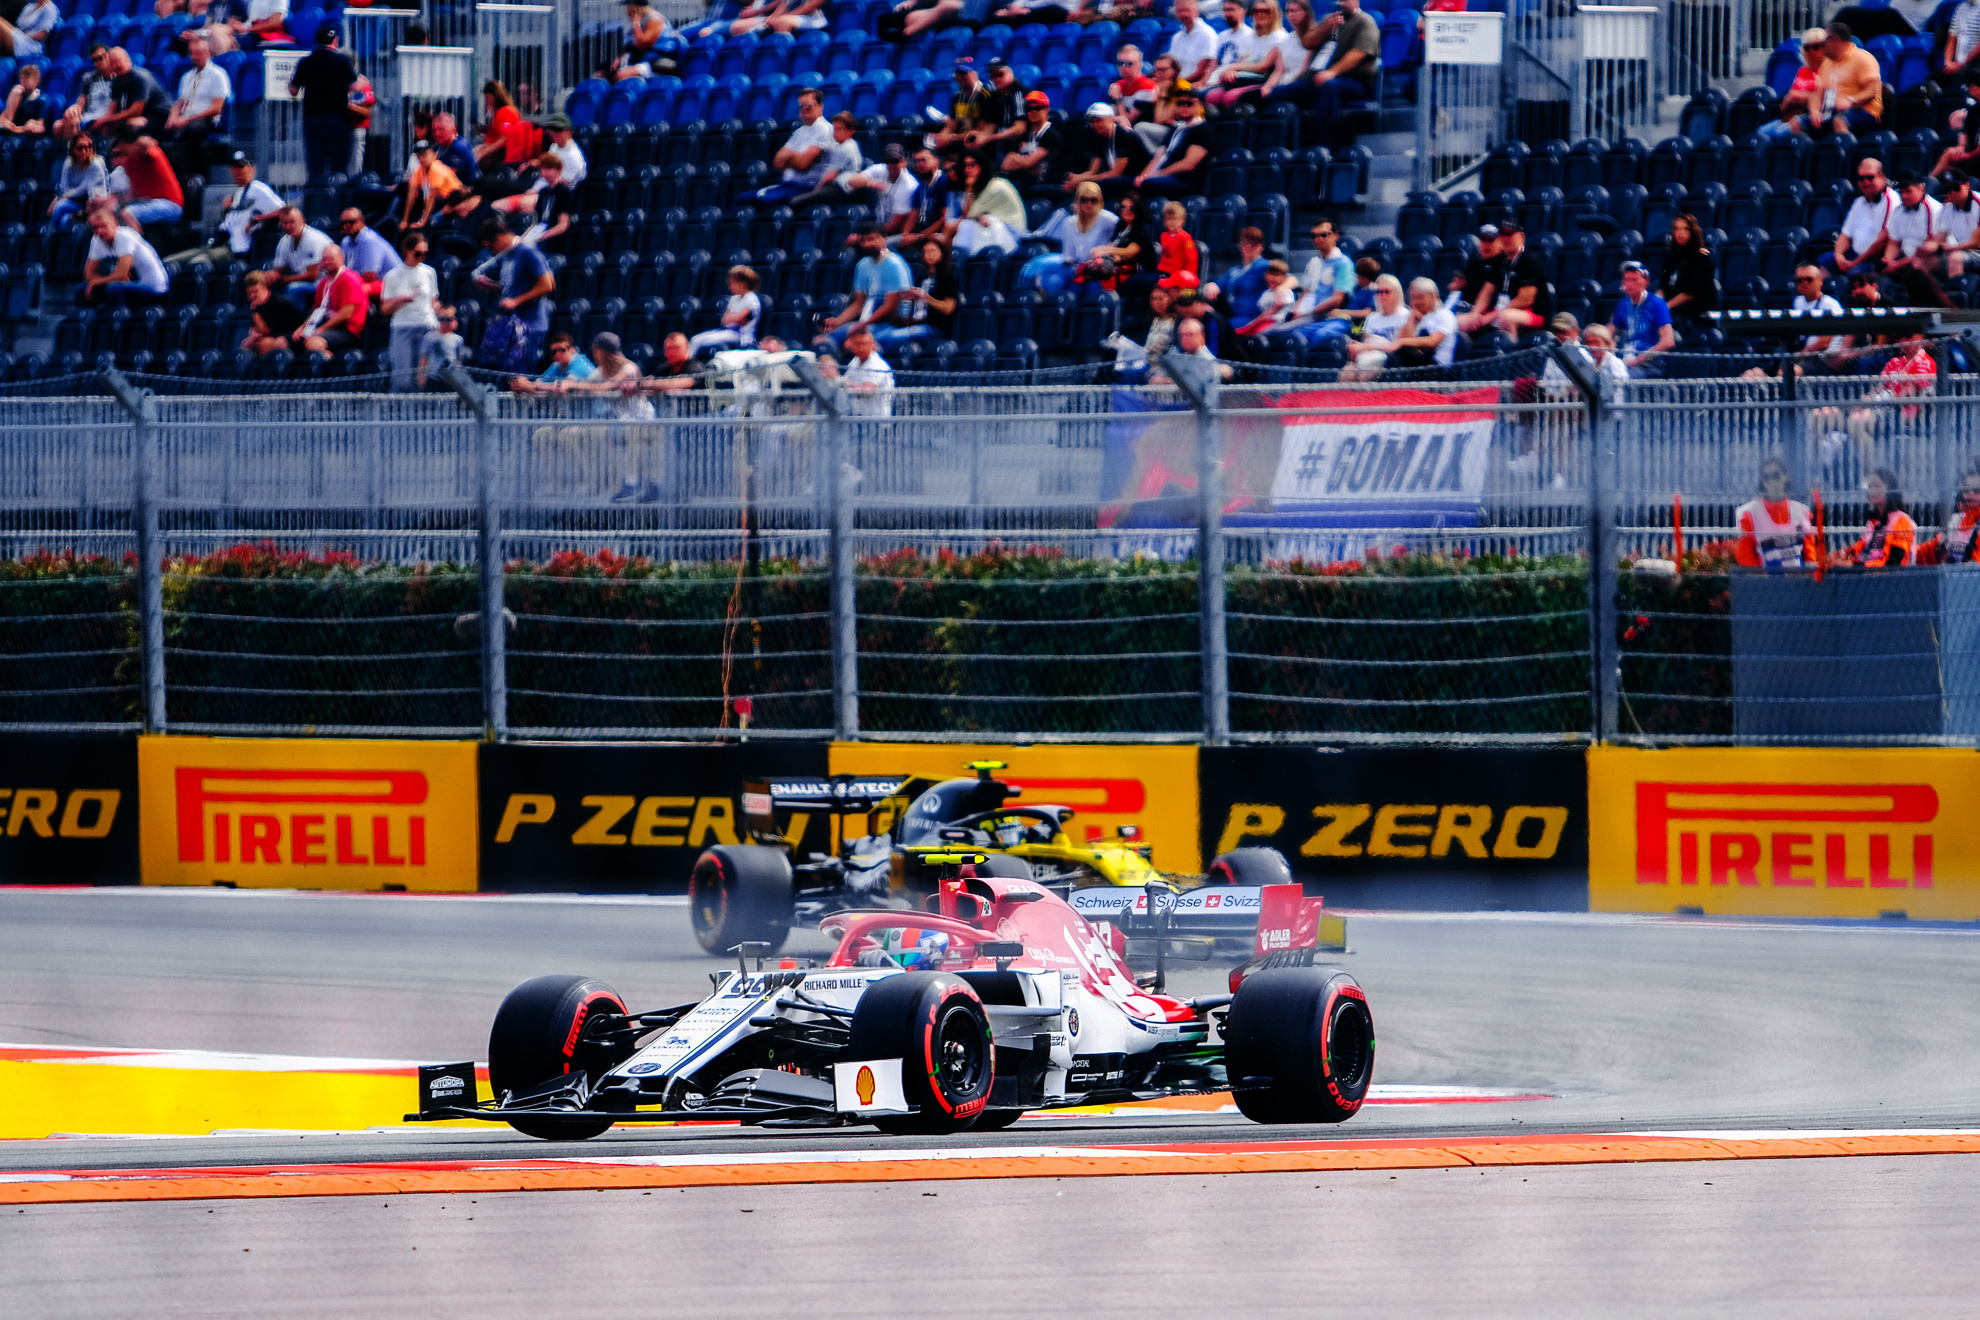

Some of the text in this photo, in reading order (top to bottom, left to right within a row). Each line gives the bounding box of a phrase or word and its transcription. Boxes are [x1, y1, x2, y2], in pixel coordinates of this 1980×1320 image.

[1296, 432, 1474, 494] #GOMAX
[174, 767, 429, 866] PIRELLI
[494, 793, 556, 844] P
[571, 795, 811, 848] ZER
[1217, 803, 1569, 859] P ZERO
[1636, 780, 1939, 889] PIRELLI
[1074, 896, 1133, 908] Schweiz
[804, 978, 862, 991] RICHARD MILLE
[939, 983, 980, 1004] ZERO
[954, 1096, 987, 1119] PIRELLI
[1326, 1081, 1362, 1111] ZERO
